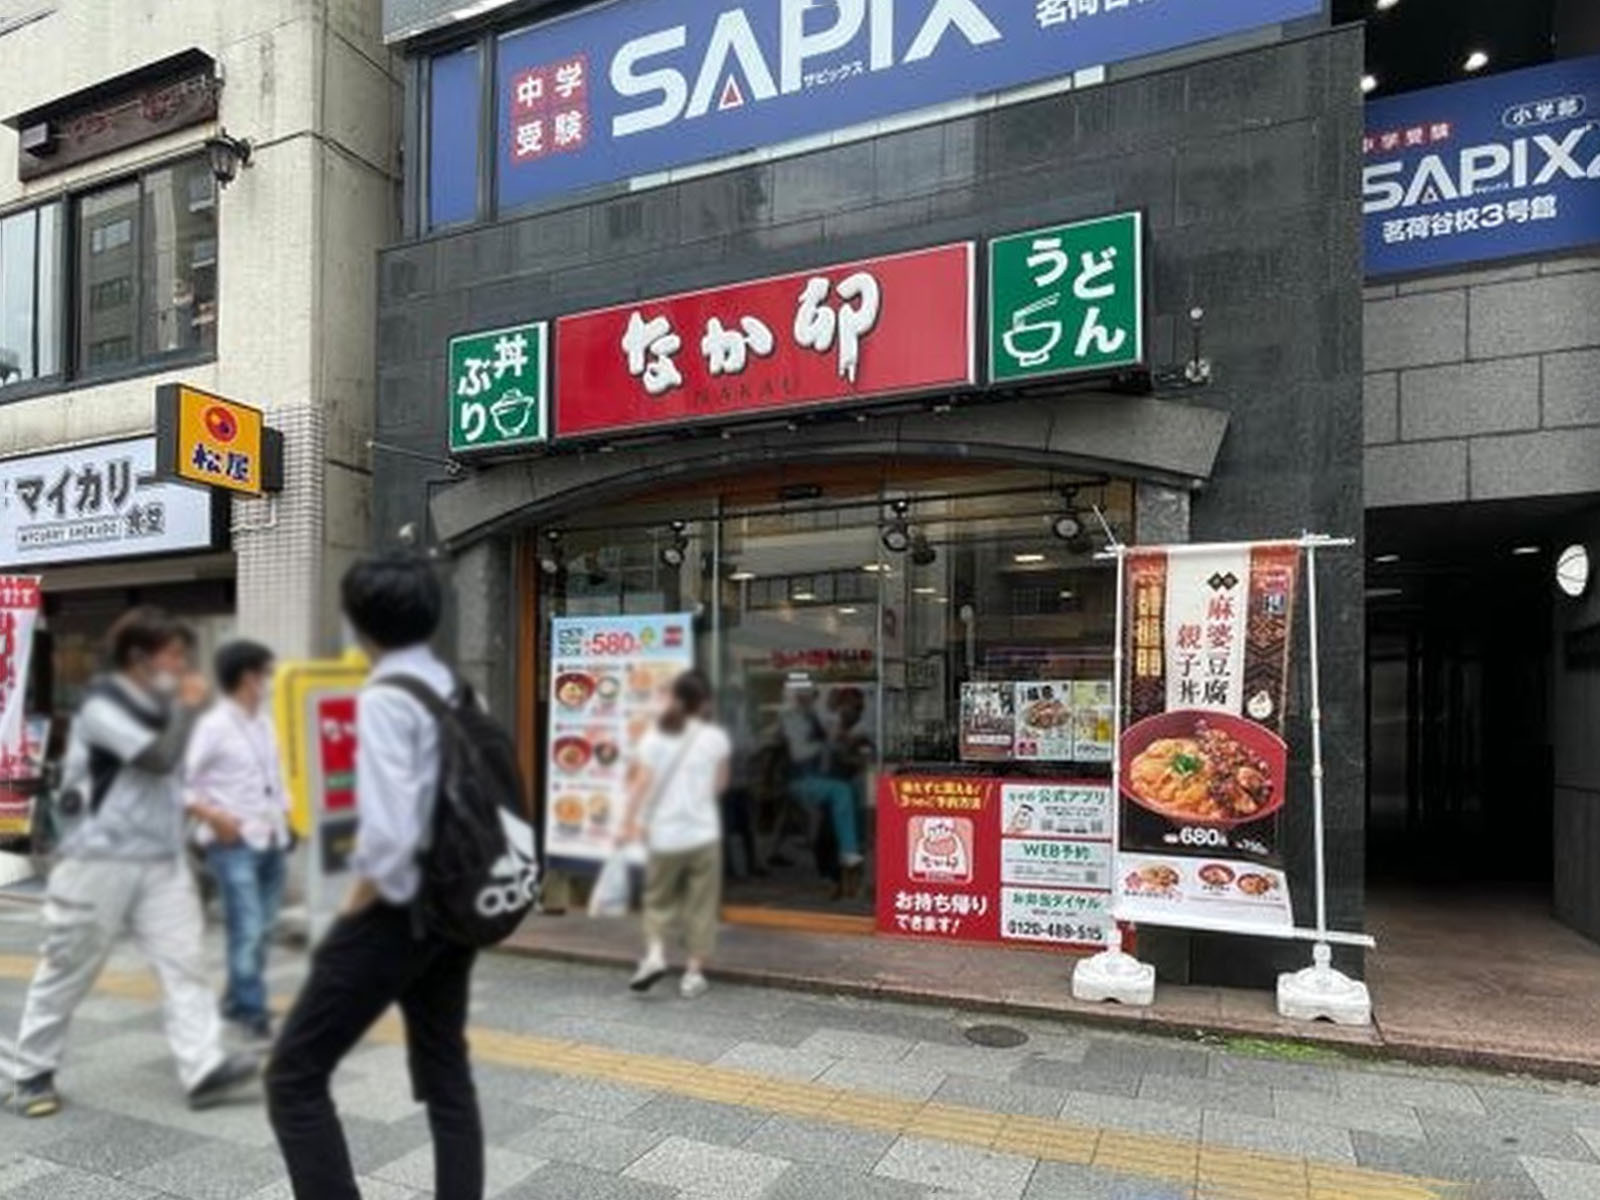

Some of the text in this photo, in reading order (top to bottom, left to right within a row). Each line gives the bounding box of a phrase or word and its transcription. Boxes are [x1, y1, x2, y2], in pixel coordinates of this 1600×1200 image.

[609, 0, 1002, 137] SAPIX
[1362, 124, 1589, 214] SAPIX
[621, 272, 882, 396] なか卯
[192, 443, 249, 482] 松屋
[894, 892, 988, 916] お持ち帰り
[895, 914, 960, 935] できます!
